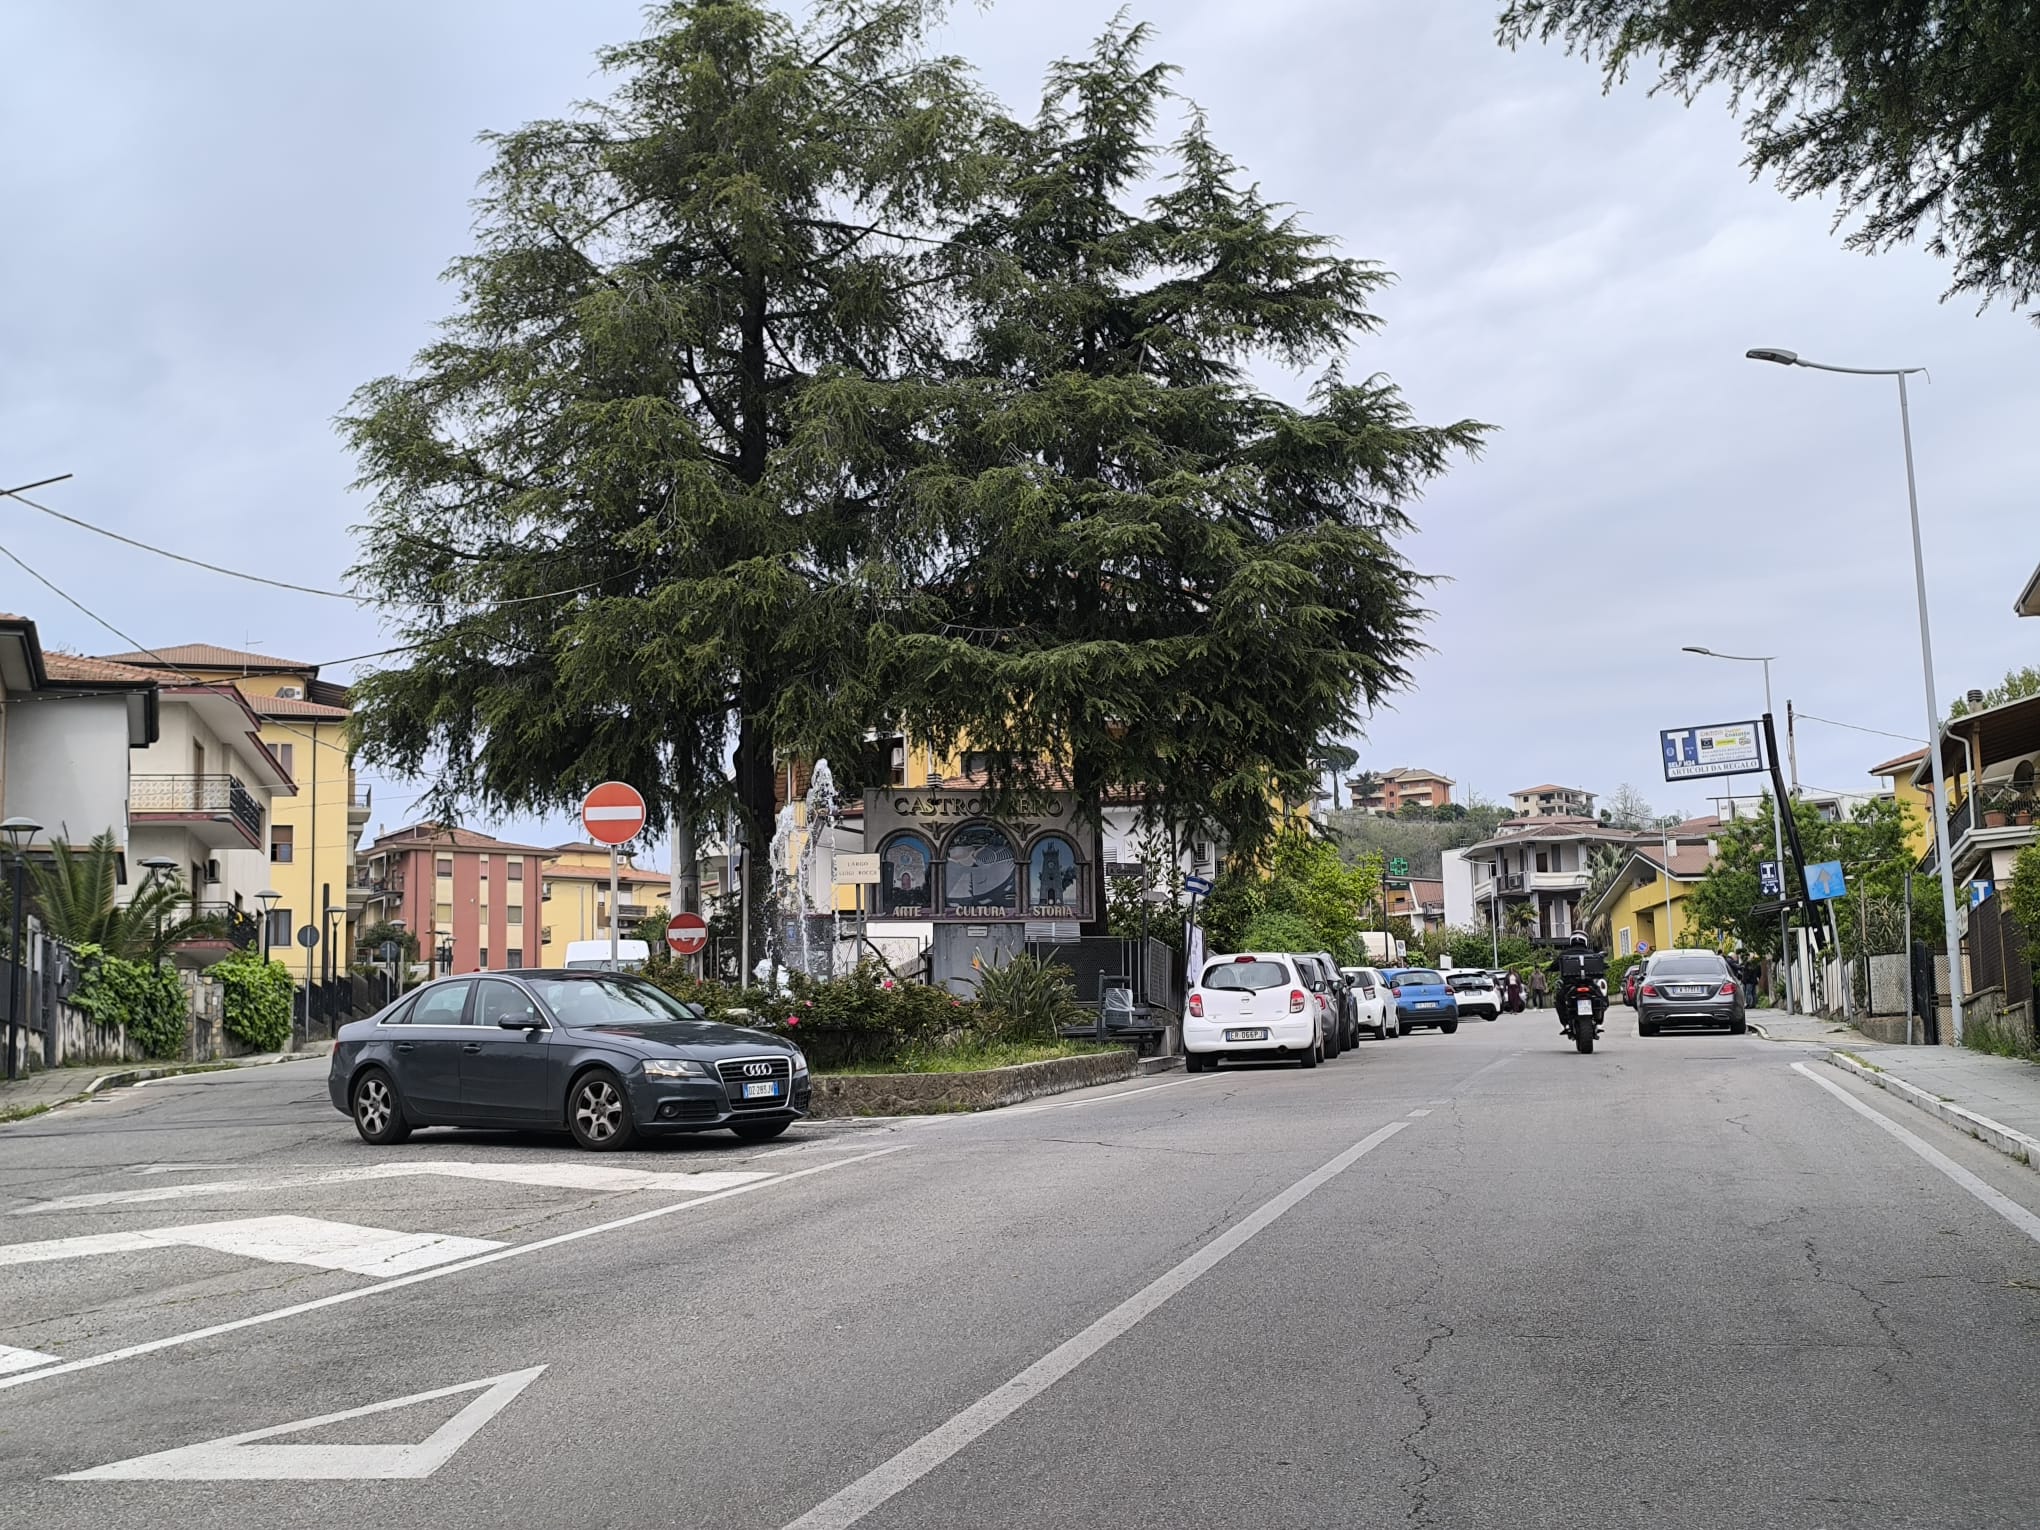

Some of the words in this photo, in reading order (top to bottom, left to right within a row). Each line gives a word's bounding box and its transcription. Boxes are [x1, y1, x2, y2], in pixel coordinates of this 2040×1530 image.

[1671, 766, 1709, 776] ARTICOLI
[1723, 761, 1757, 770] REGALO
[894, 797, 1063, 816] CASTROLERO
[892, 905, 922, 917] ARTE
[955, 905, 1006, 917] CULTURA
[1033, 905, 1073, 917] STORIA
